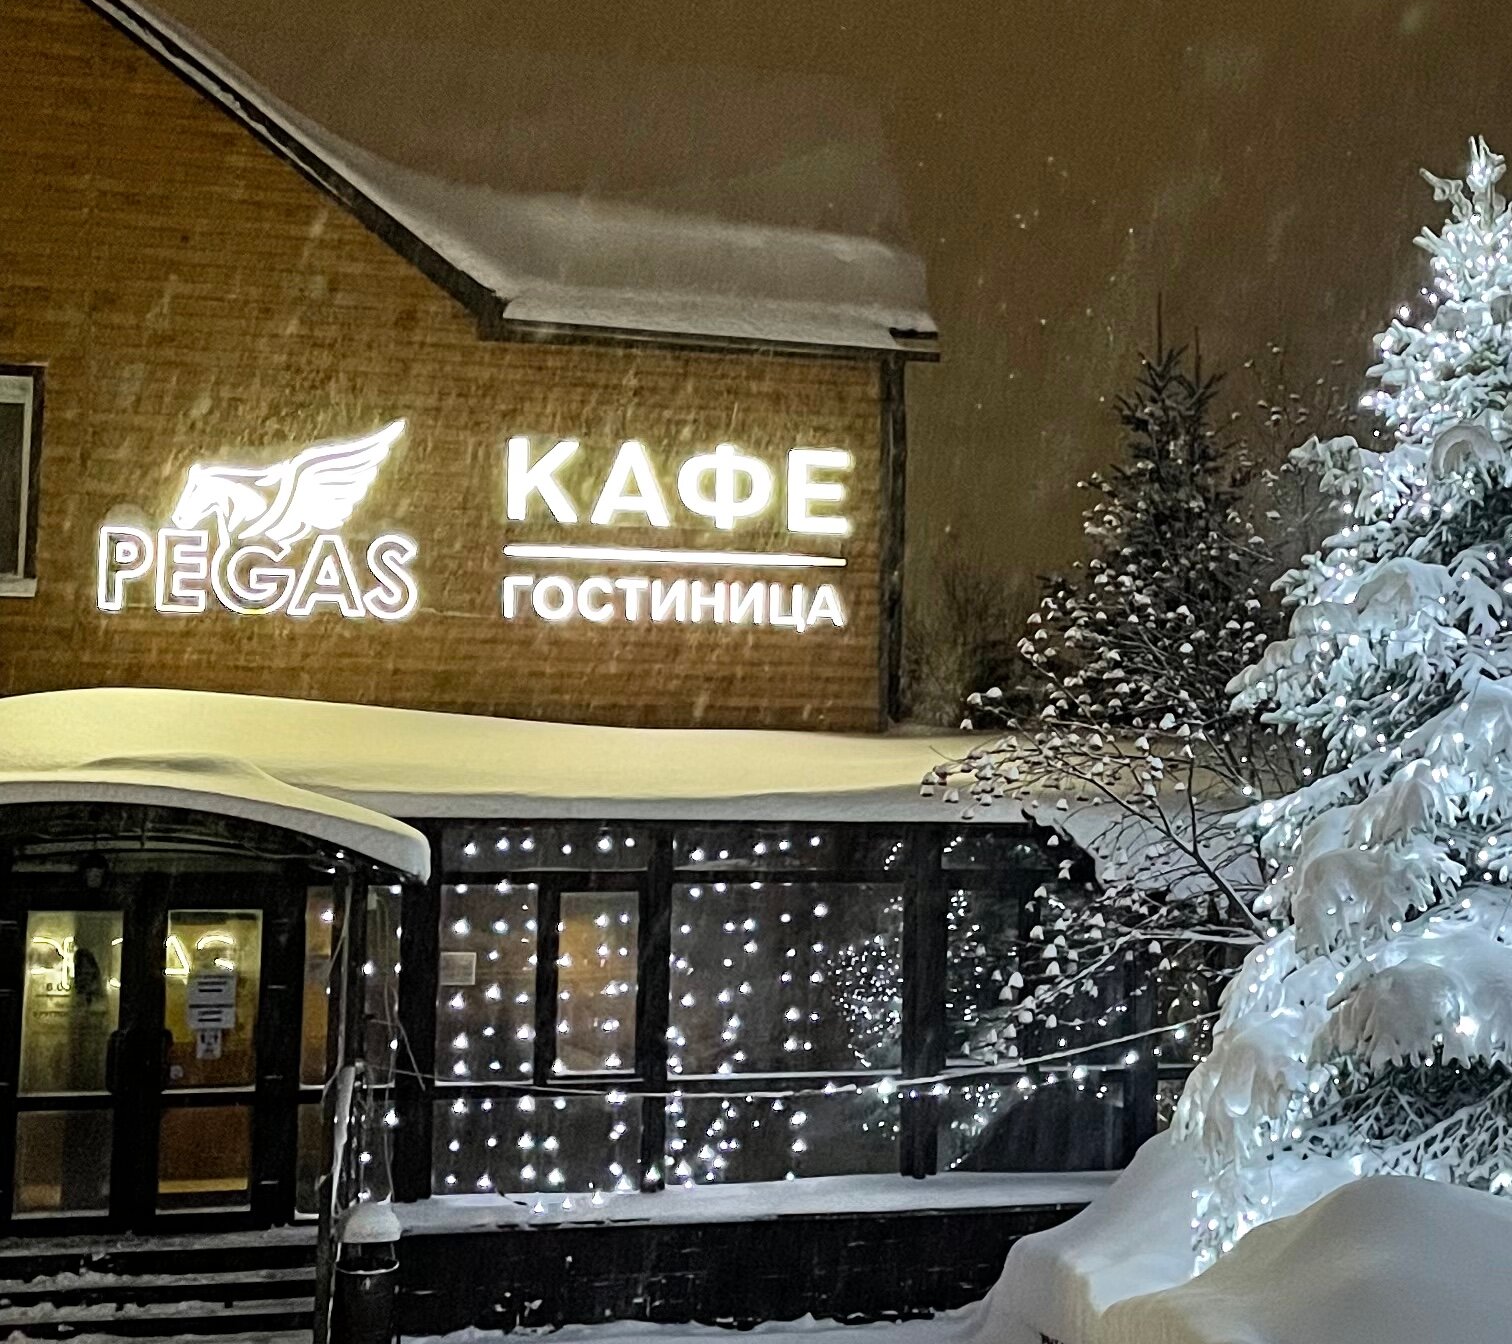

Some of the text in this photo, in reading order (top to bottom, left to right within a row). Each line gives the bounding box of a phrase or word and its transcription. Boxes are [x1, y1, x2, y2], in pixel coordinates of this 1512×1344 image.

[504, 436, 852, 536] КАФЕ
[96, 523, 418, 620] PEGAS
[502, 574, 846, 632] ГОСТИНИЦА
